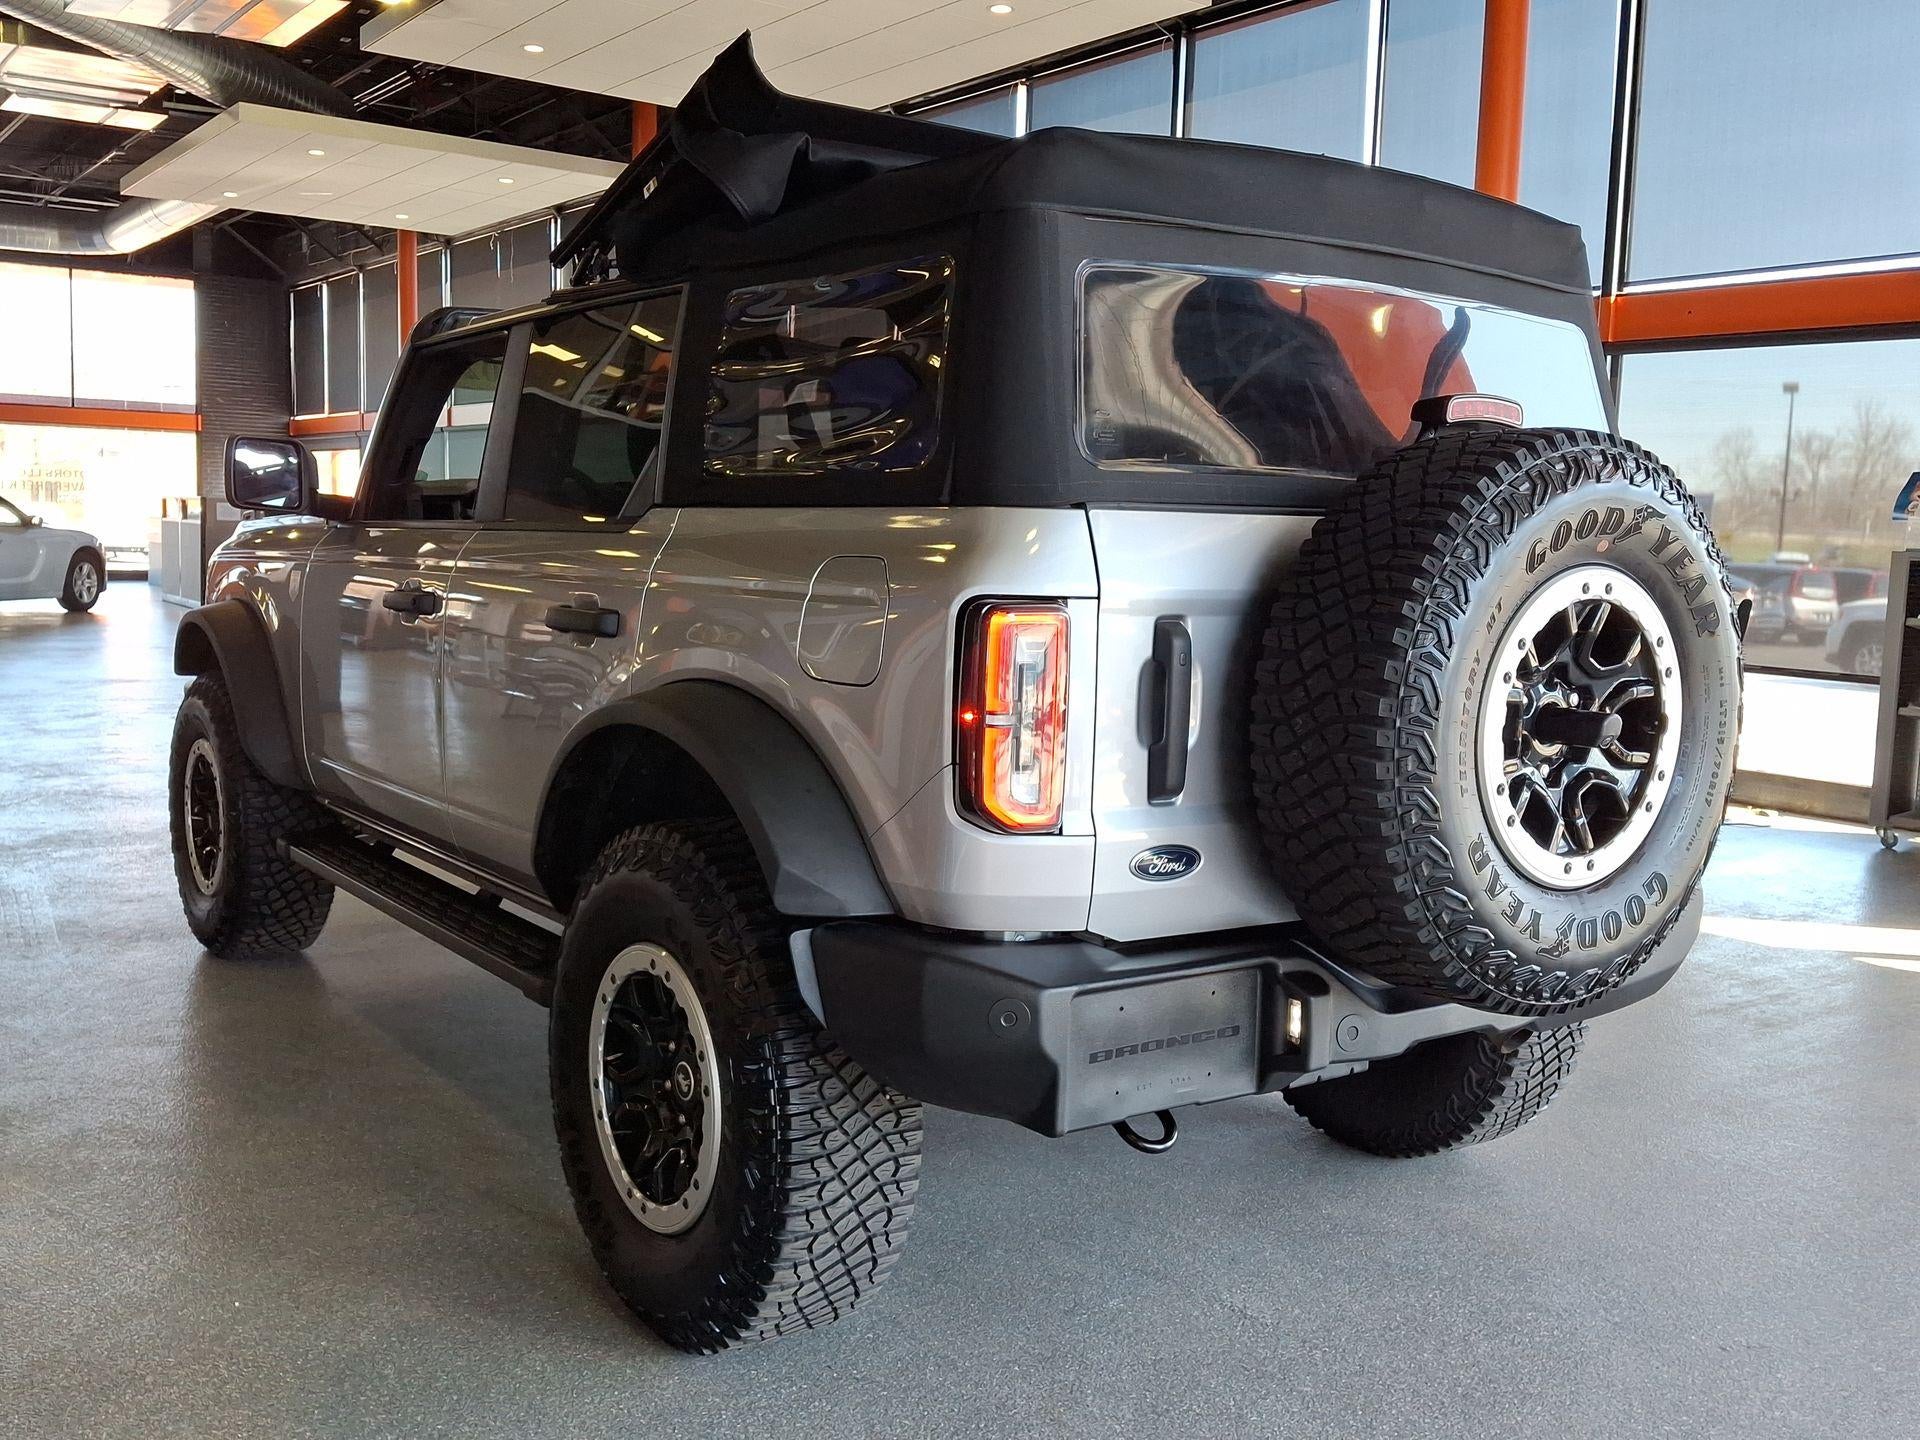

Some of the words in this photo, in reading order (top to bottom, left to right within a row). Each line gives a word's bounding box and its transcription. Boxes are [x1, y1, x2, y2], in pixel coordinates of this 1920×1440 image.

[1458, 648, 1481, 798] TERRITORY
[1485, 596, 1503, 634] MT
[1704, 699, 1728, 808] LT315/70R17
[1148, 854, 1187, 874] Ford
[1089, 1025, 1240, 1065] BRONCO
